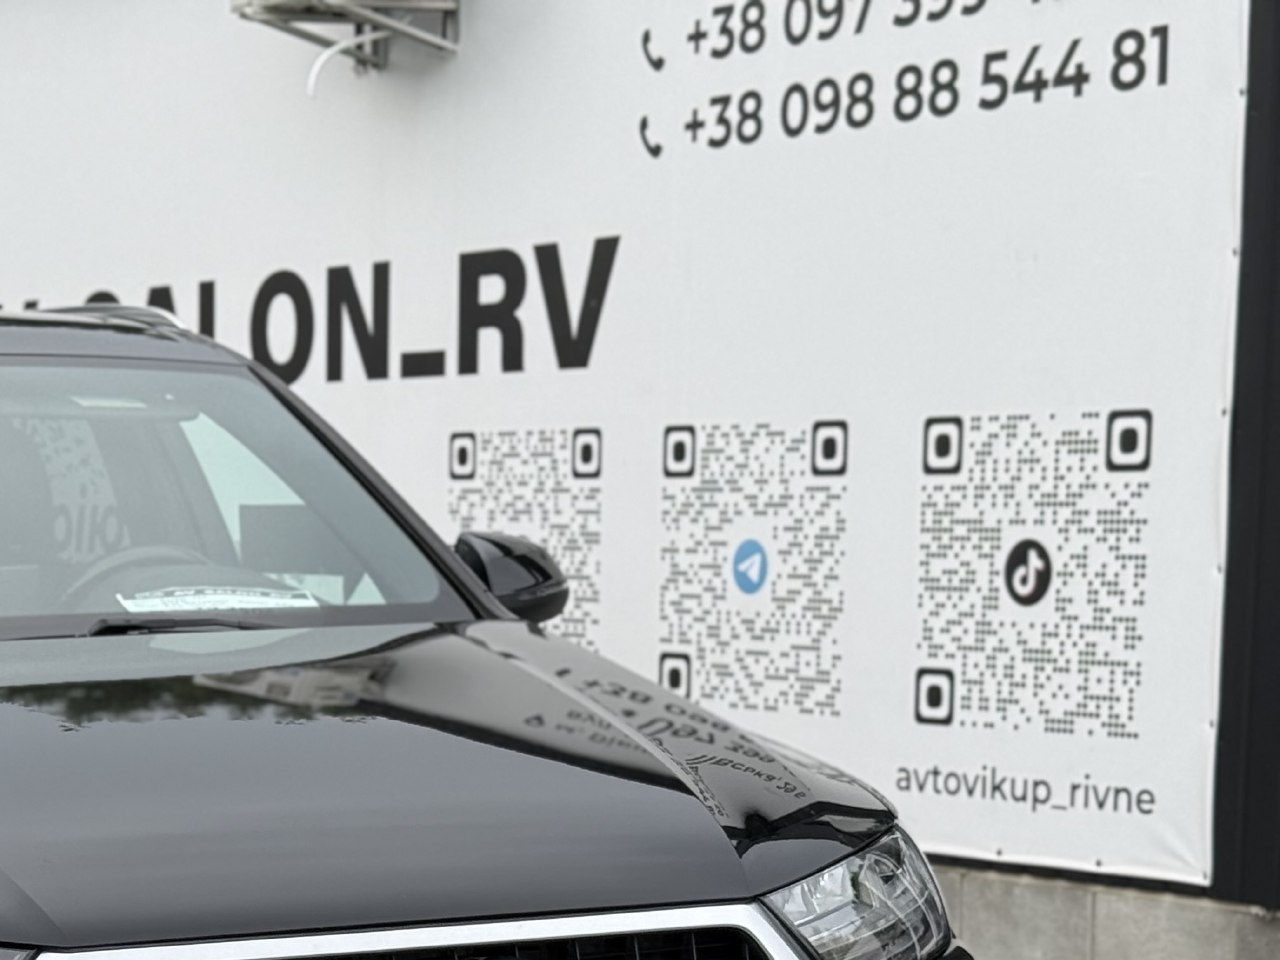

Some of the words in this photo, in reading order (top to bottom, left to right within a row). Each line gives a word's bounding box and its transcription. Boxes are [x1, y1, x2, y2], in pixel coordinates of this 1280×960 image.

[686, 0, 766, 60] +38
[684, 89, 763, 149] +38
[780, 72, 875, 139] 098
[893, 58, 960, 123] 88
[978, 38, 1091, 111] 544
[1110, 24, 1169, 92] 81
[895, 764, 1156, 816] avtovikup_rivne
